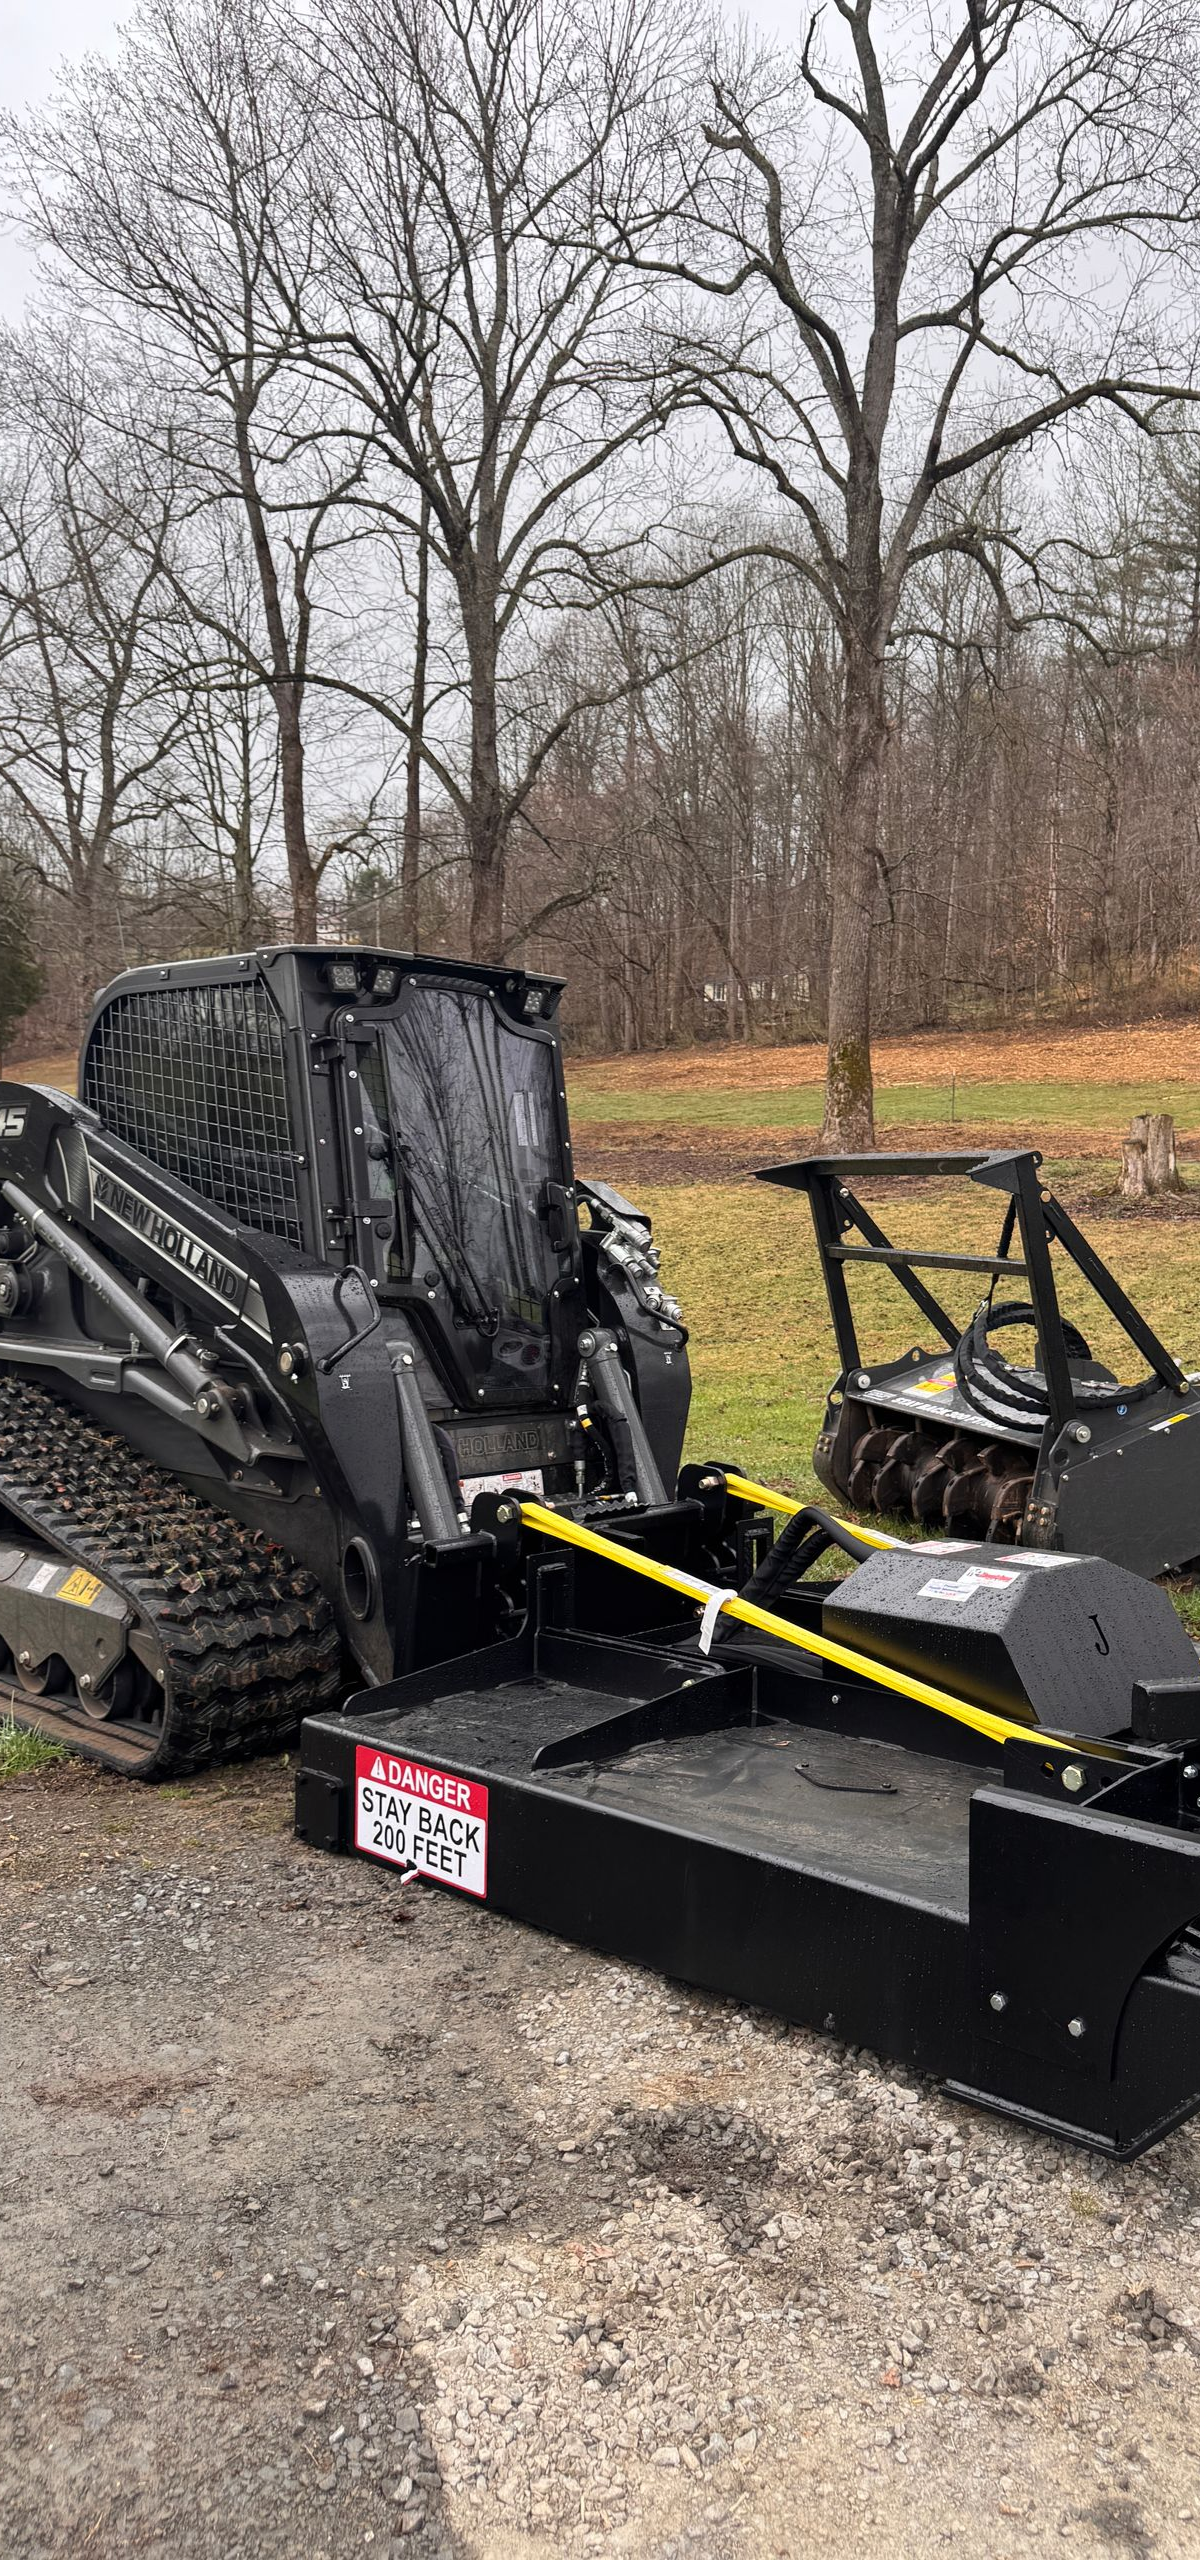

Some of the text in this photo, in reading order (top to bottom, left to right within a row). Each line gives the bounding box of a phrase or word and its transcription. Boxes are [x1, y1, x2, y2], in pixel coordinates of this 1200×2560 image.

[110, 1185, 238, 1301] NEW HOLLAND
[459, 1430, 540, 1457] HOLLAND
[388, 1760, 471, 1811] DANGER
[362, 1786, 481, 1854] STAY BACK
[372, 1820, 467, 1878] 200 FEET
